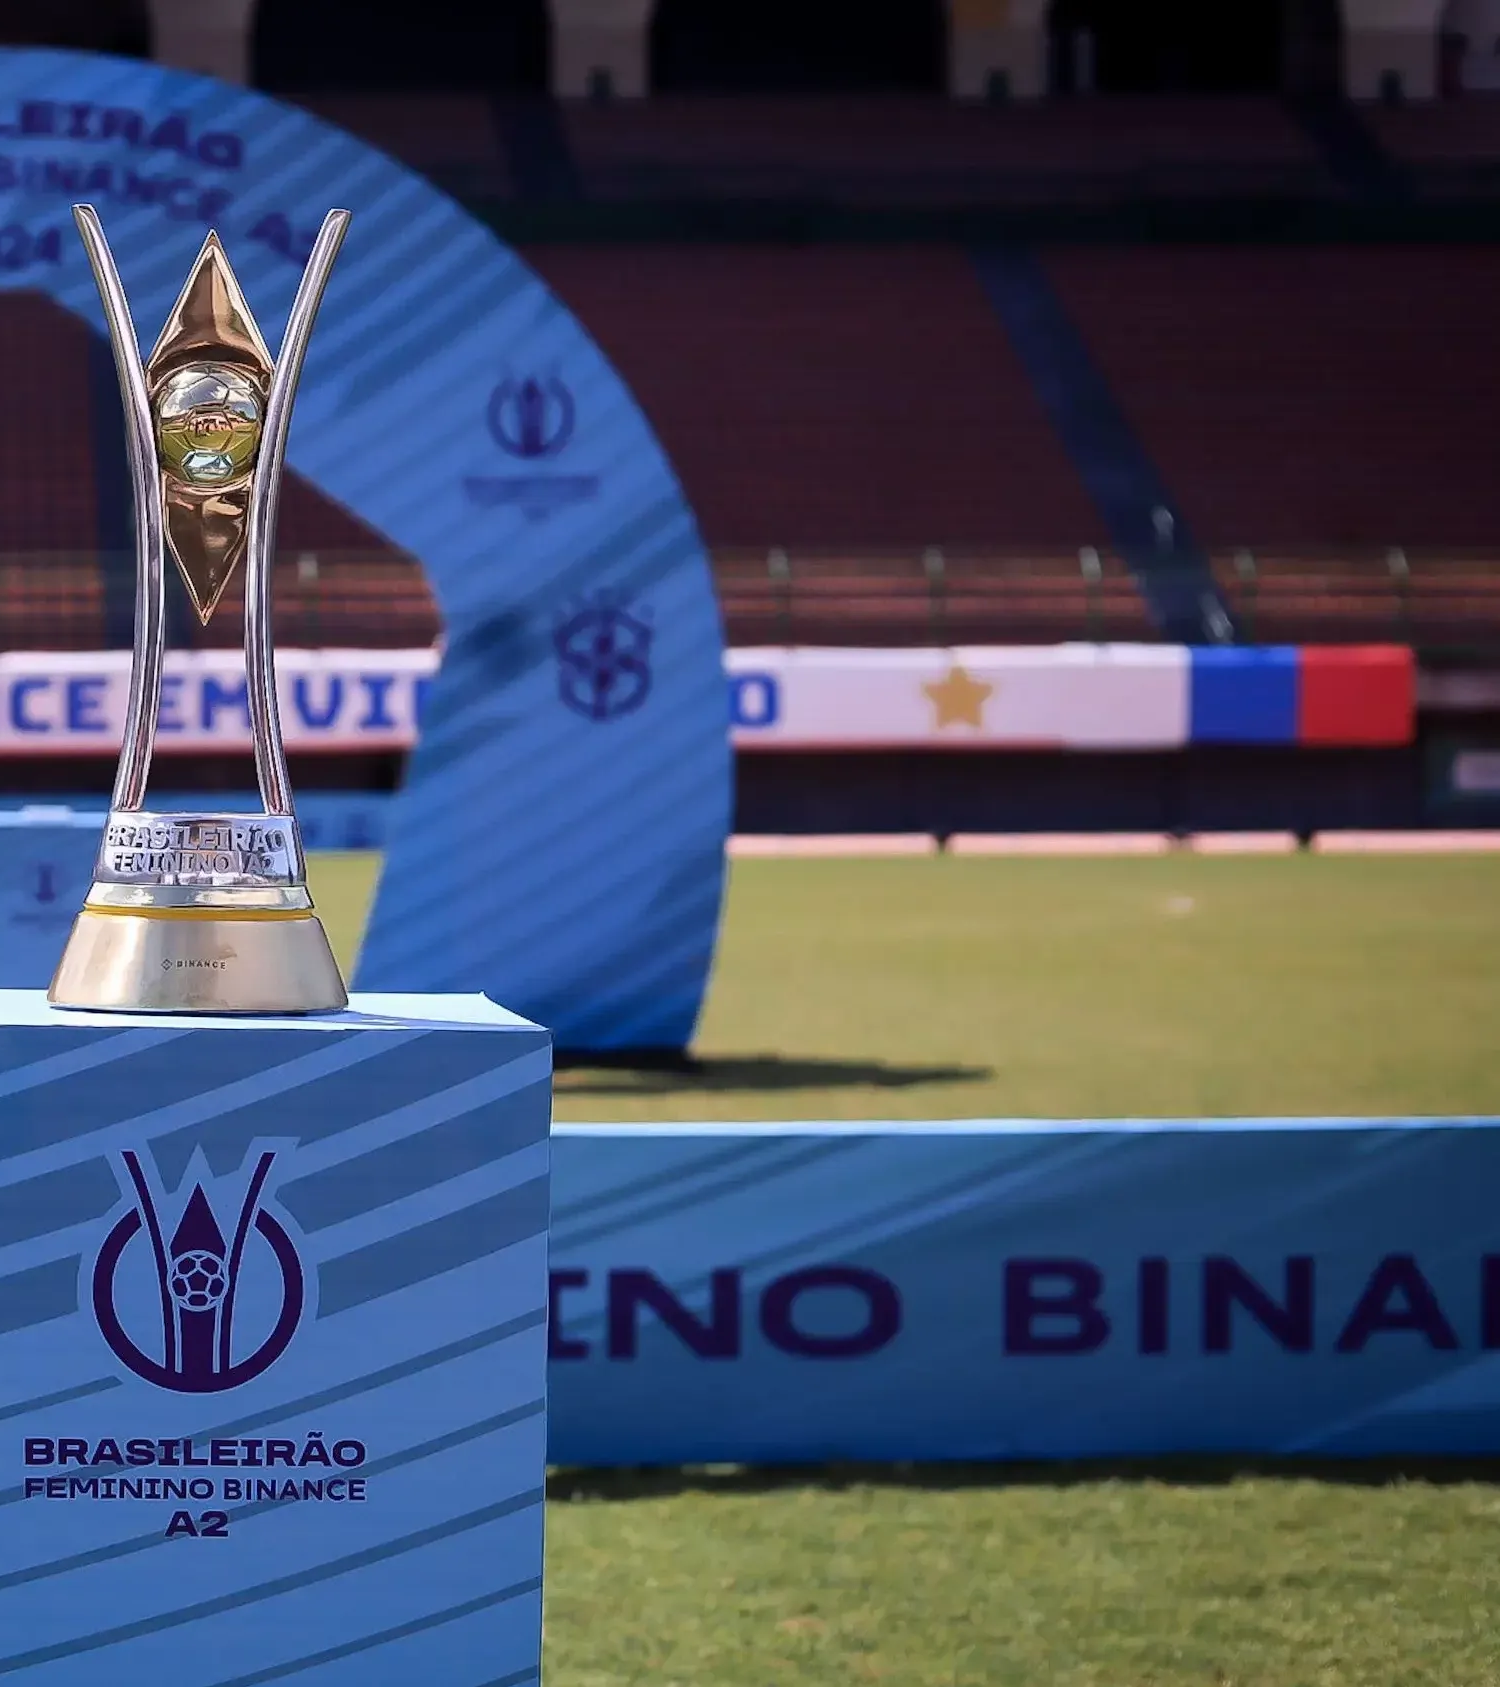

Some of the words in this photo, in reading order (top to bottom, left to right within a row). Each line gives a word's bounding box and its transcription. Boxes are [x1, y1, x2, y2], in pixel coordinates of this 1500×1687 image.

[155, 675, 250, 732] EM
[107, 823, 286, 851] BRASILEIRÃO
[113, 851, 232, 874] FEMININO
[248, 853, 277, 874] A2
[176, 959, 227, 970] BINANCE
[1002, 1253, 1500, 1356] BINA
[23, 1431, 365, 1467] BRASILEIRÃO
[24, 1477, 214, 1499] FEMININO
[223, 1479, 366, 1501] BINANCE
[164, 1510, 229, 1537] A2
